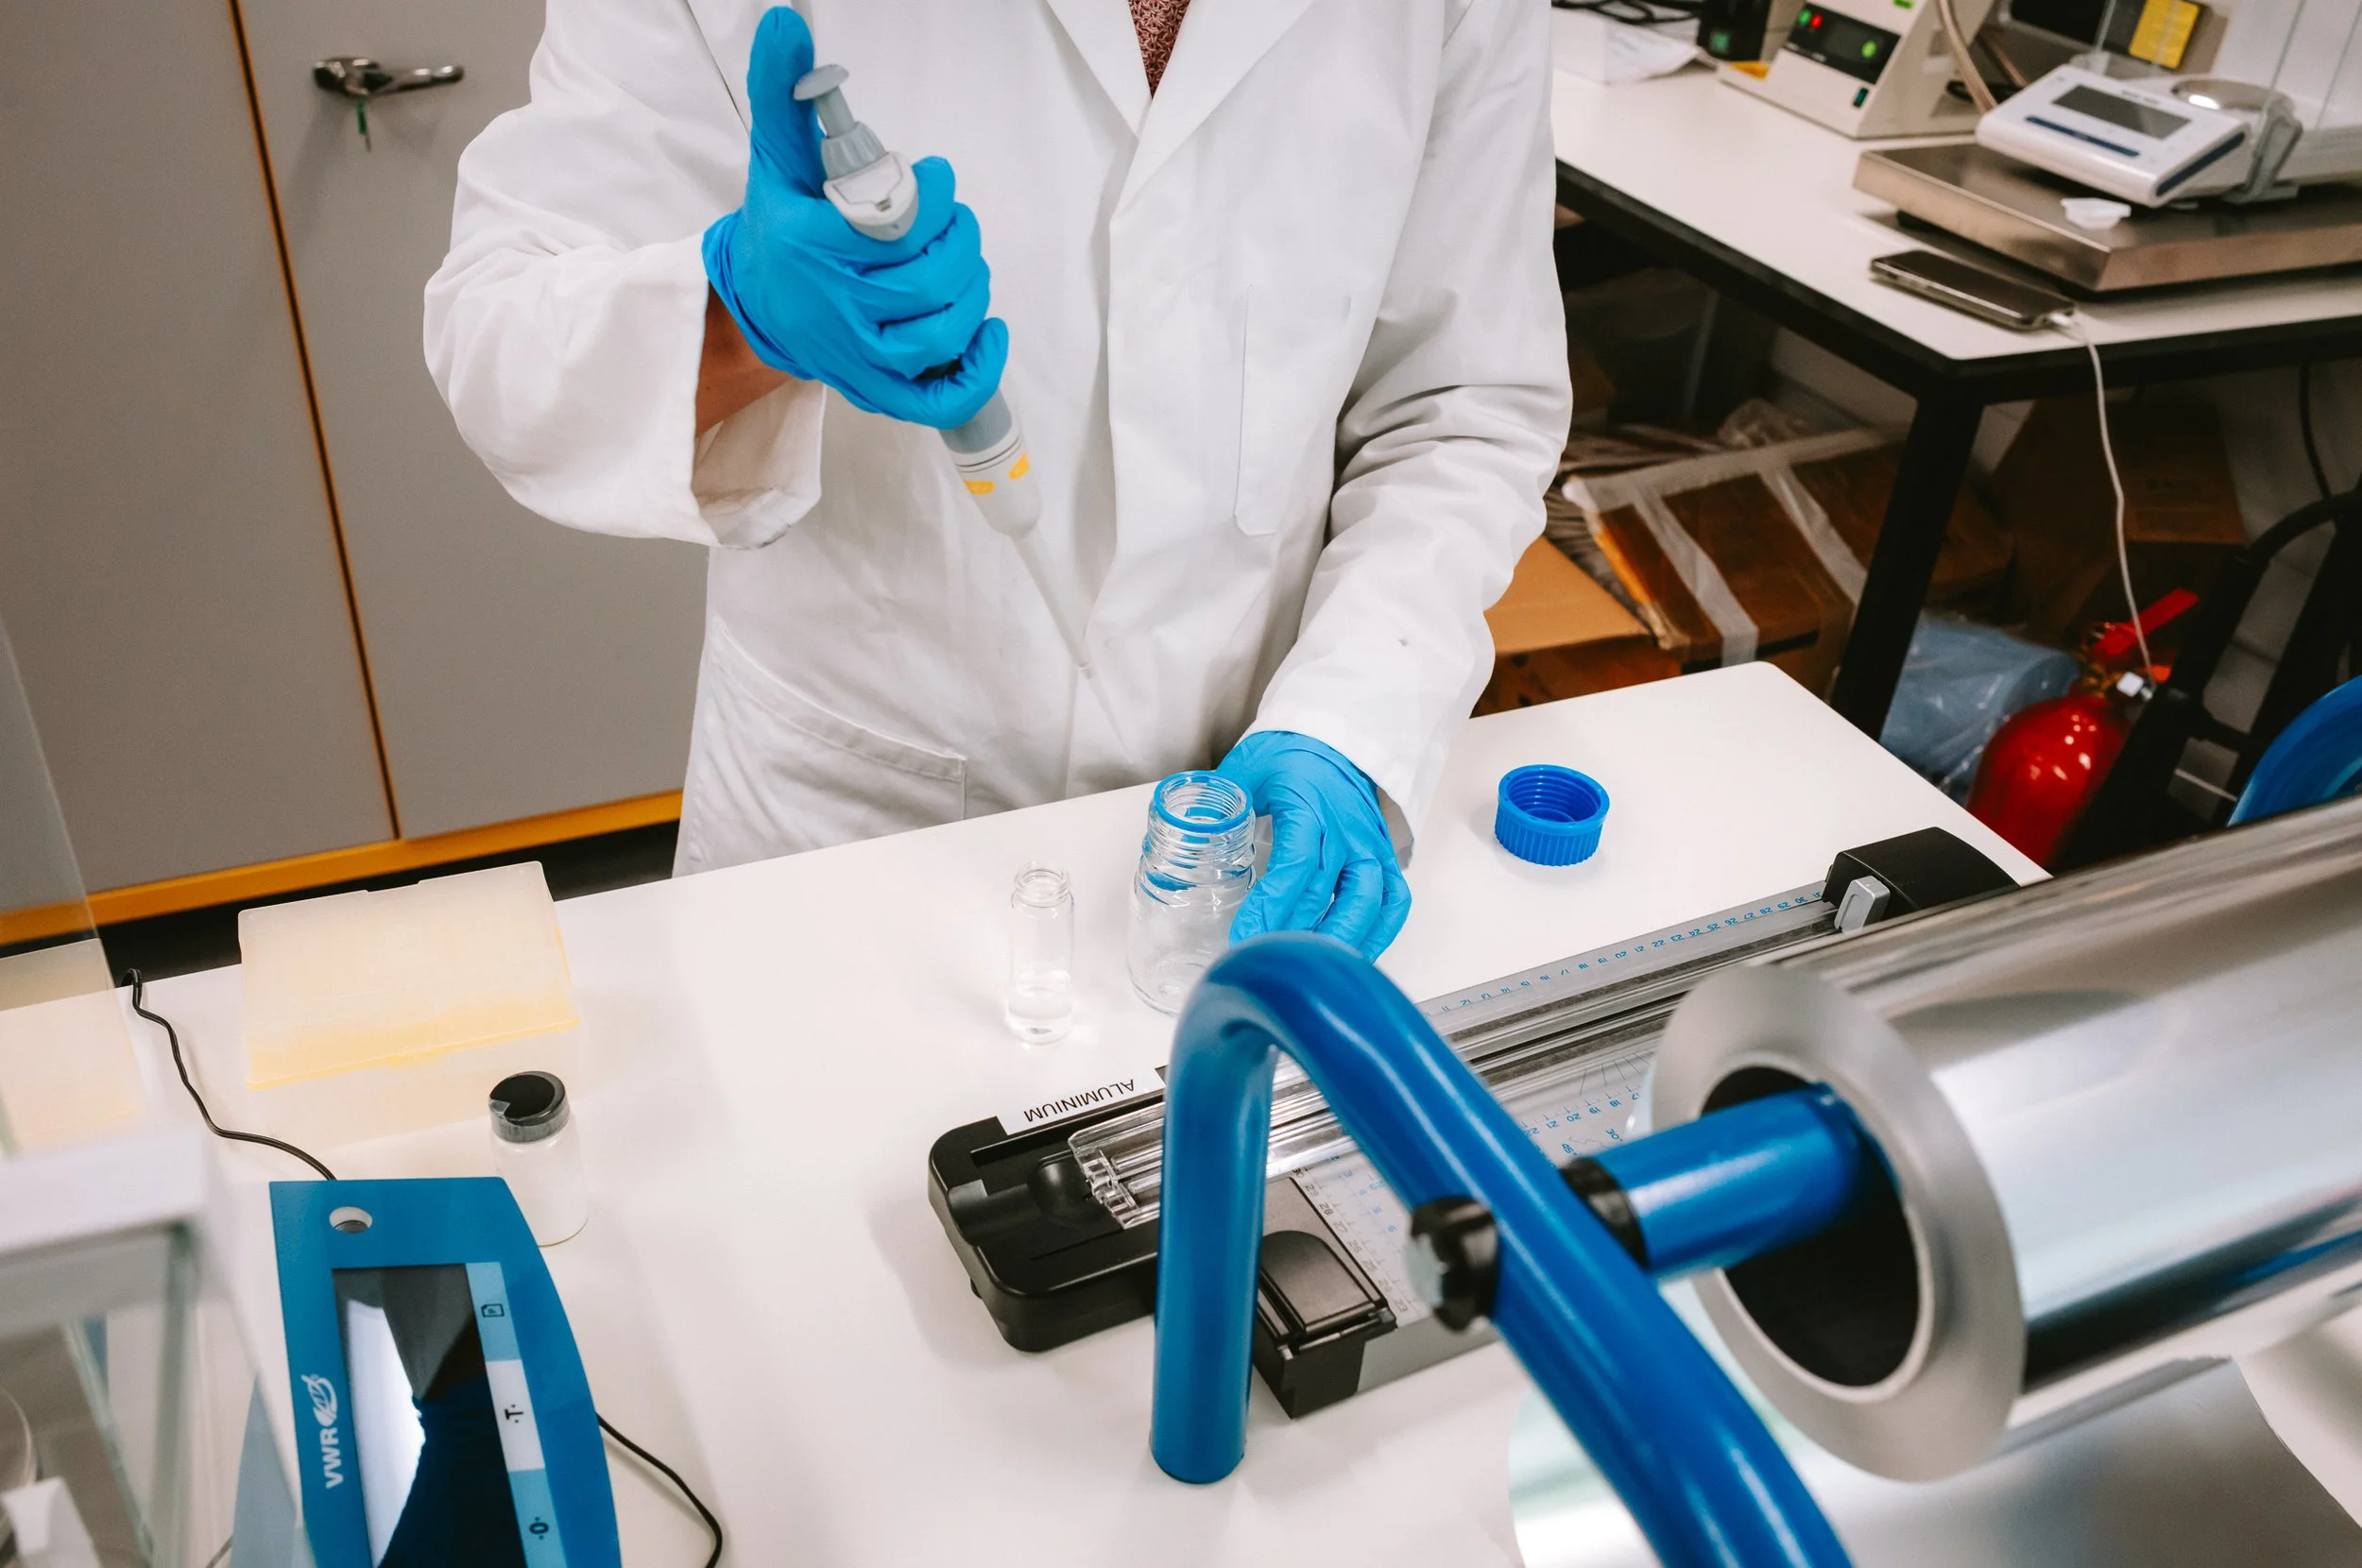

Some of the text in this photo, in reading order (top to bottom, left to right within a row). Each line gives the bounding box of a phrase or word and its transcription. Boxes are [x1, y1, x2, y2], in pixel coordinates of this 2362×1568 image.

[1777, 901, 1791, 910] 29
[1759, 907, 1772, 915] 28
[1724, 917, 1737, 926] 26
[1688, 929, 1703, 937] 24
[1652, 939, 1666, 947] 22
[1023, 1079, 1135, 1122] ALUMINIUM
[1609, 1099, 1621, 1108] 18
[1588, 1106, 1601, 1115] 19
[1566, 1113, 1582, 1122] 20
[1547, 1120, 1560, 1130] 21
[1319, 1202, 1334, 1216] 28
[319, 1426, 344, 1490] VWR
